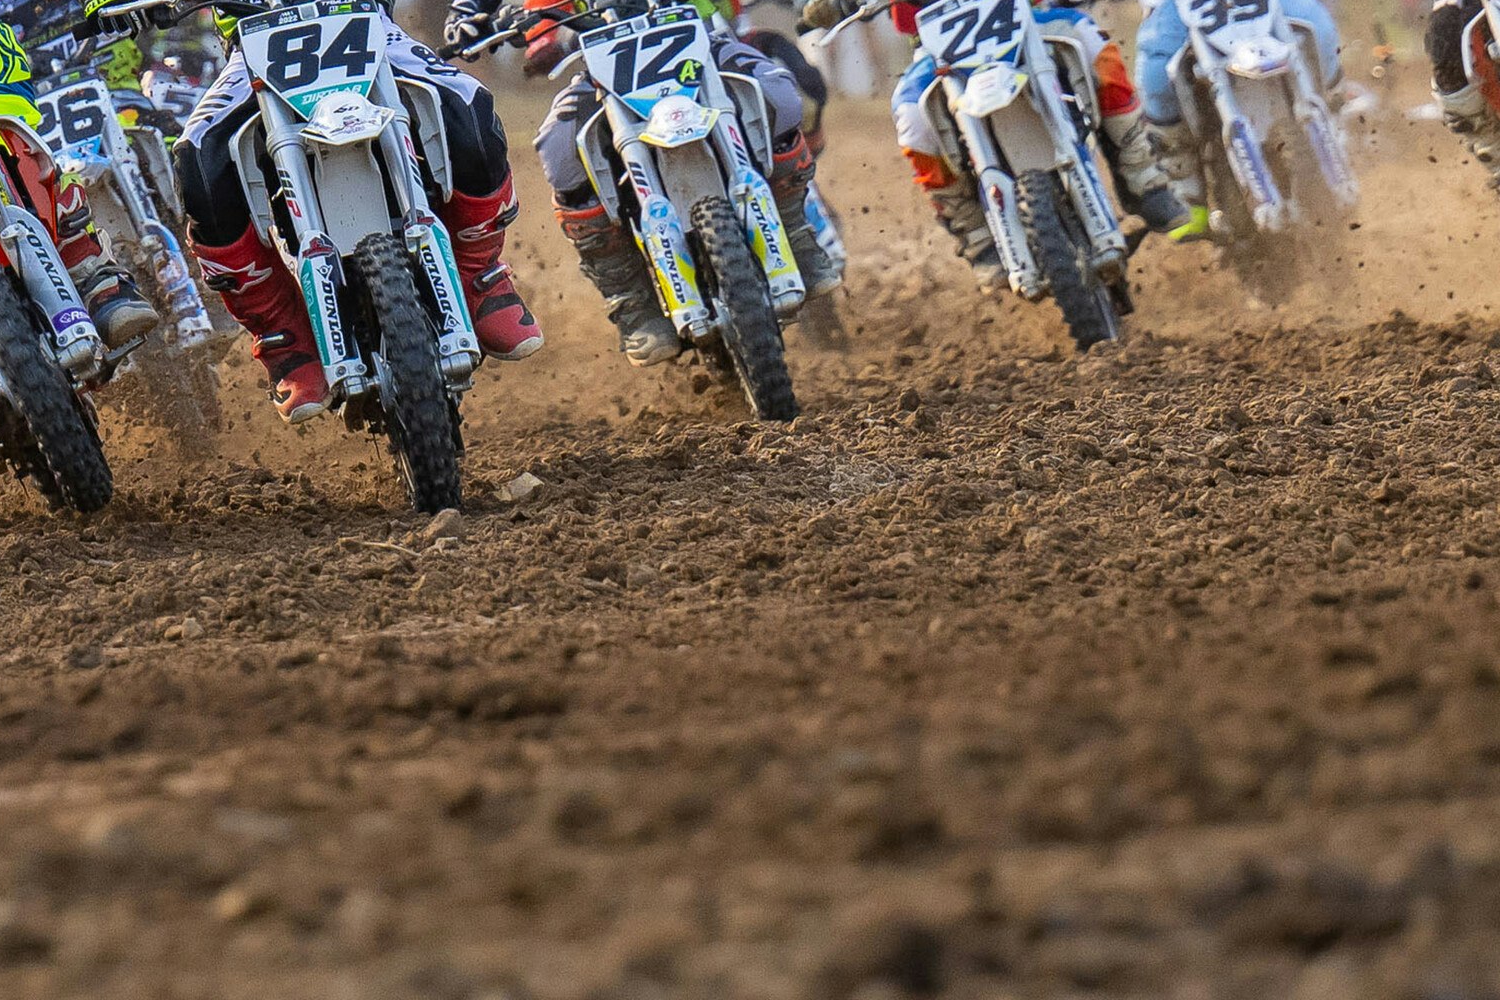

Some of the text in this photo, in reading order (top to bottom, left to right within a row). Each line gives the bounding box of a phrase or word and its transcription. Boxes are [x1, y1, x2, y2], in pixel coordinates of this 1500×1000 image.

[267, 17, 377, 93] 84
[607, 24, 696, 97] 12
[661, 237, 687, 304] DUNLOP
[321, 281, 345, 357] DUNLOP
